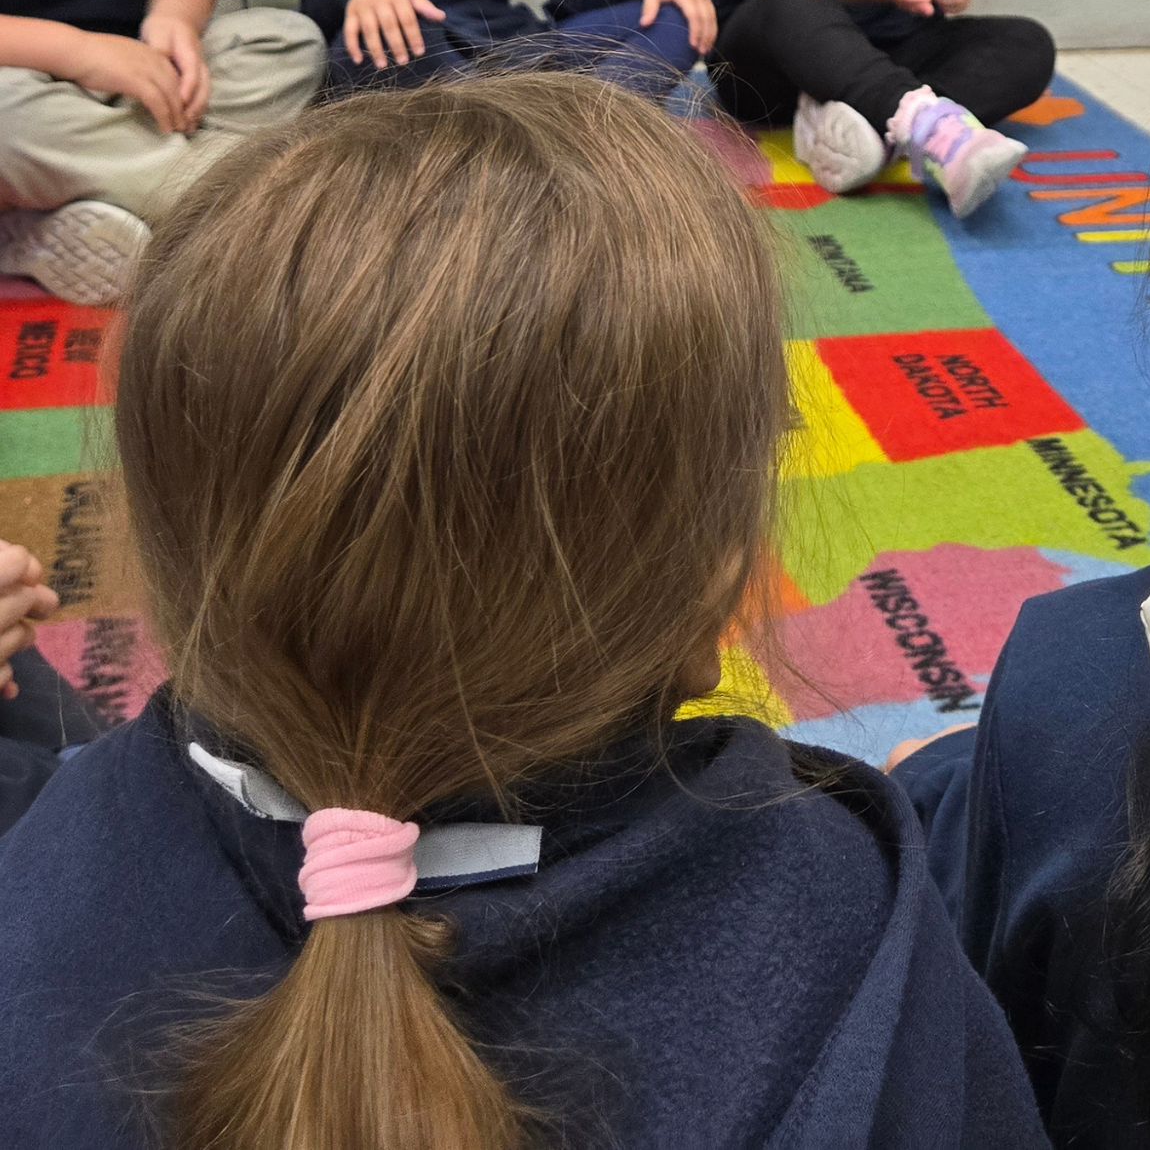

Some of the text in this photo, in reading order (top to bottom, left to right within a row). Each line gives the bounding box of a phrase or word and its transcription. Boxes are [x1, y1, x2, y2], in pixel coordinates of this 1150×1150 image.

[9, 319, 58, 379] MEXICO
[893, 353, 968, 420] DAKOTA
[941, 353, 1011, 410] NORTH
[859, 567, 982, 714] WISCONSIN
